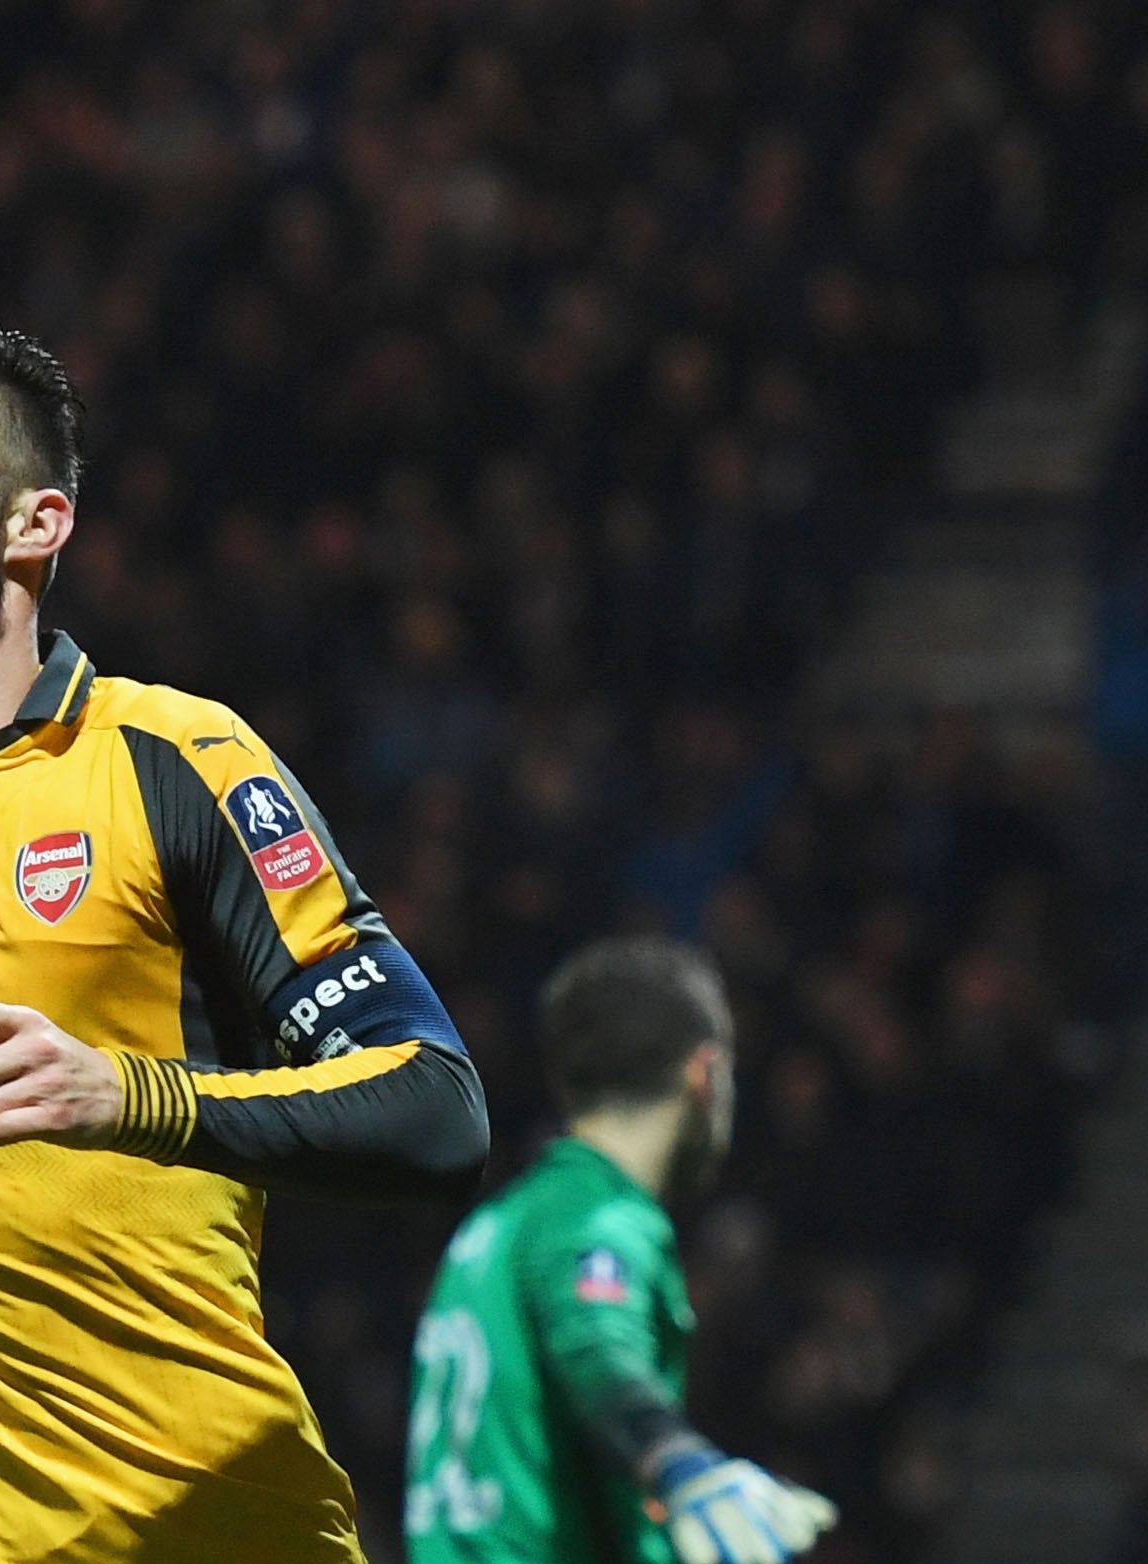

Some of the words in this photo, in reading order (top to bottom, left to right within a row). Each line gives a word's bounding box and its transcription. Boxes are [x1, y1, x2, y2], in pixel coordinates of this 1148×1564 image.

[24, 841, 83, 867] Arsenal
[263, 846, 312, 874] Emirates
[276, 869, 292, 882] FA
[290, 860, 311, 875] CUP
